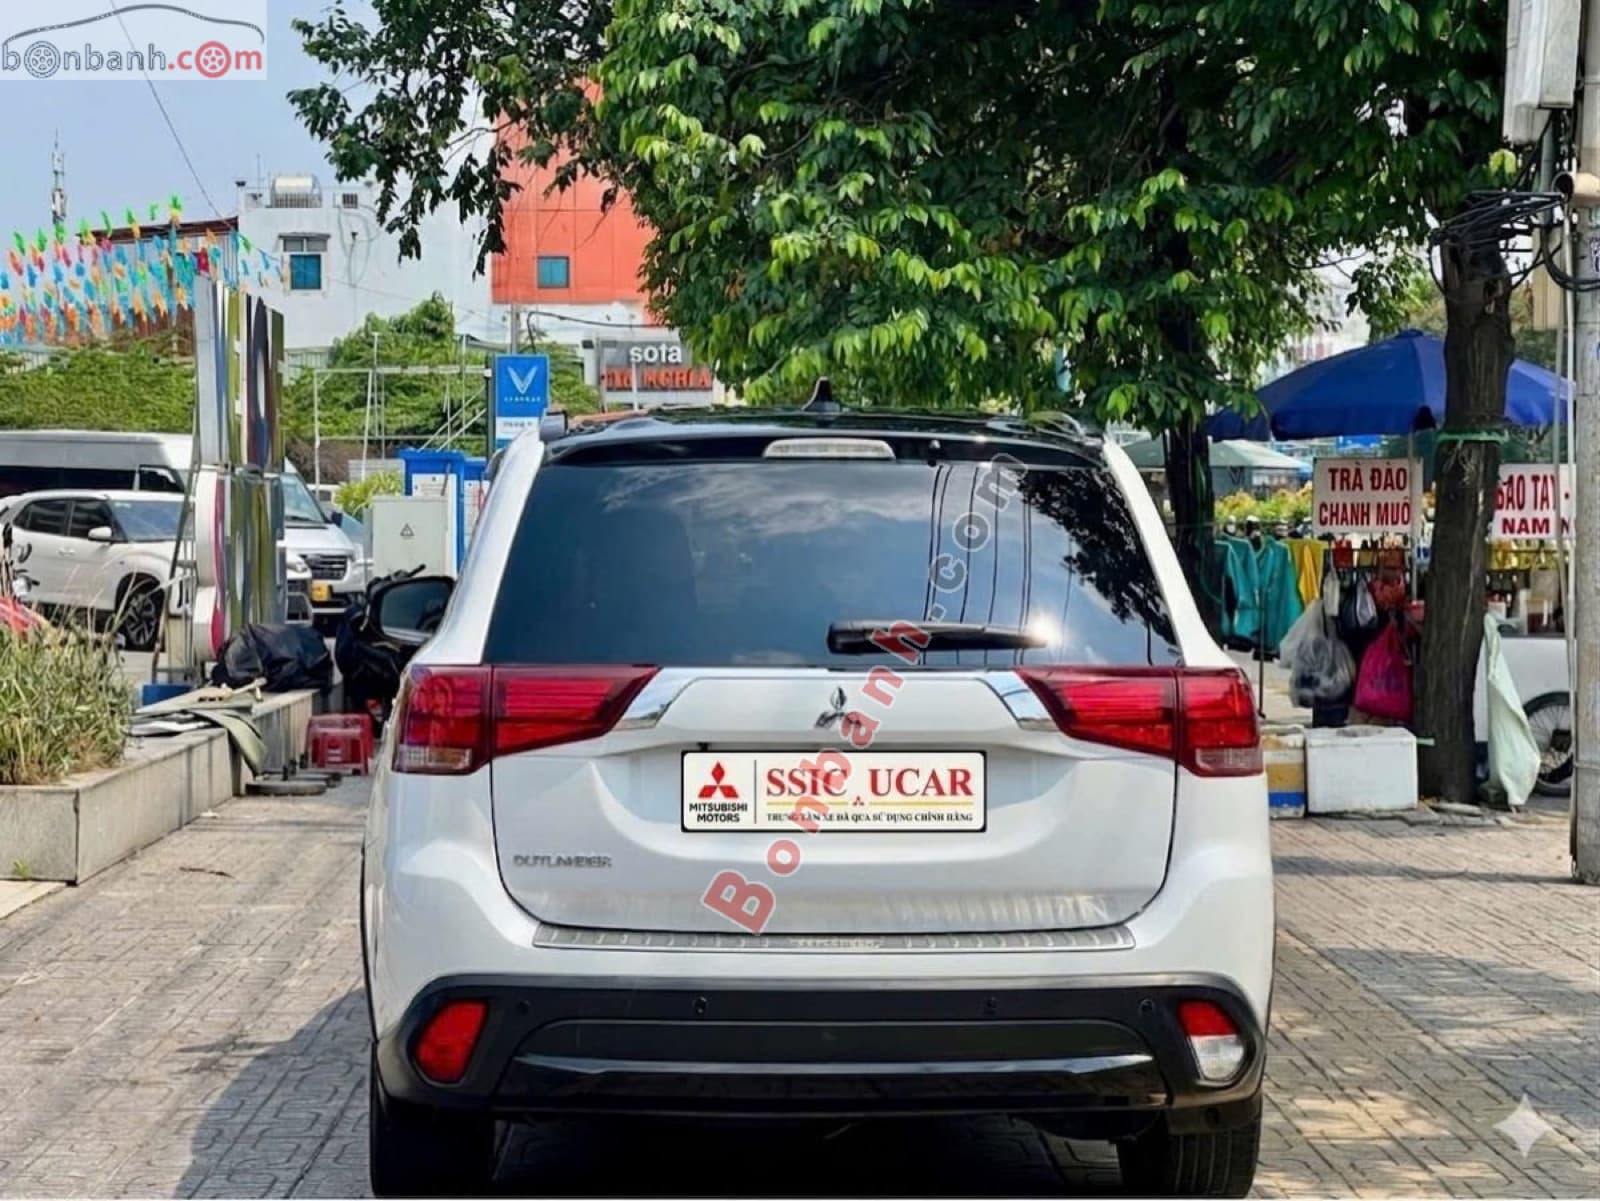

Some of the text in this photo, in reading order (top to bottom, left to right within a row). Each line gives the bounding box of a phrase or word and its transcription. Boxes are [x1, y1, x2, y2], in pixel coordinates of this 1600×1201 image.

[1319, 502, 1371, 526] CHANH
[1502, 517, 1550, 535] NAM
[766, 768, 973, 797] SSIC UCAR
[689, 803, 748, 813] MITSUBISHI
[697, 813, 740, 823] MOTORS
